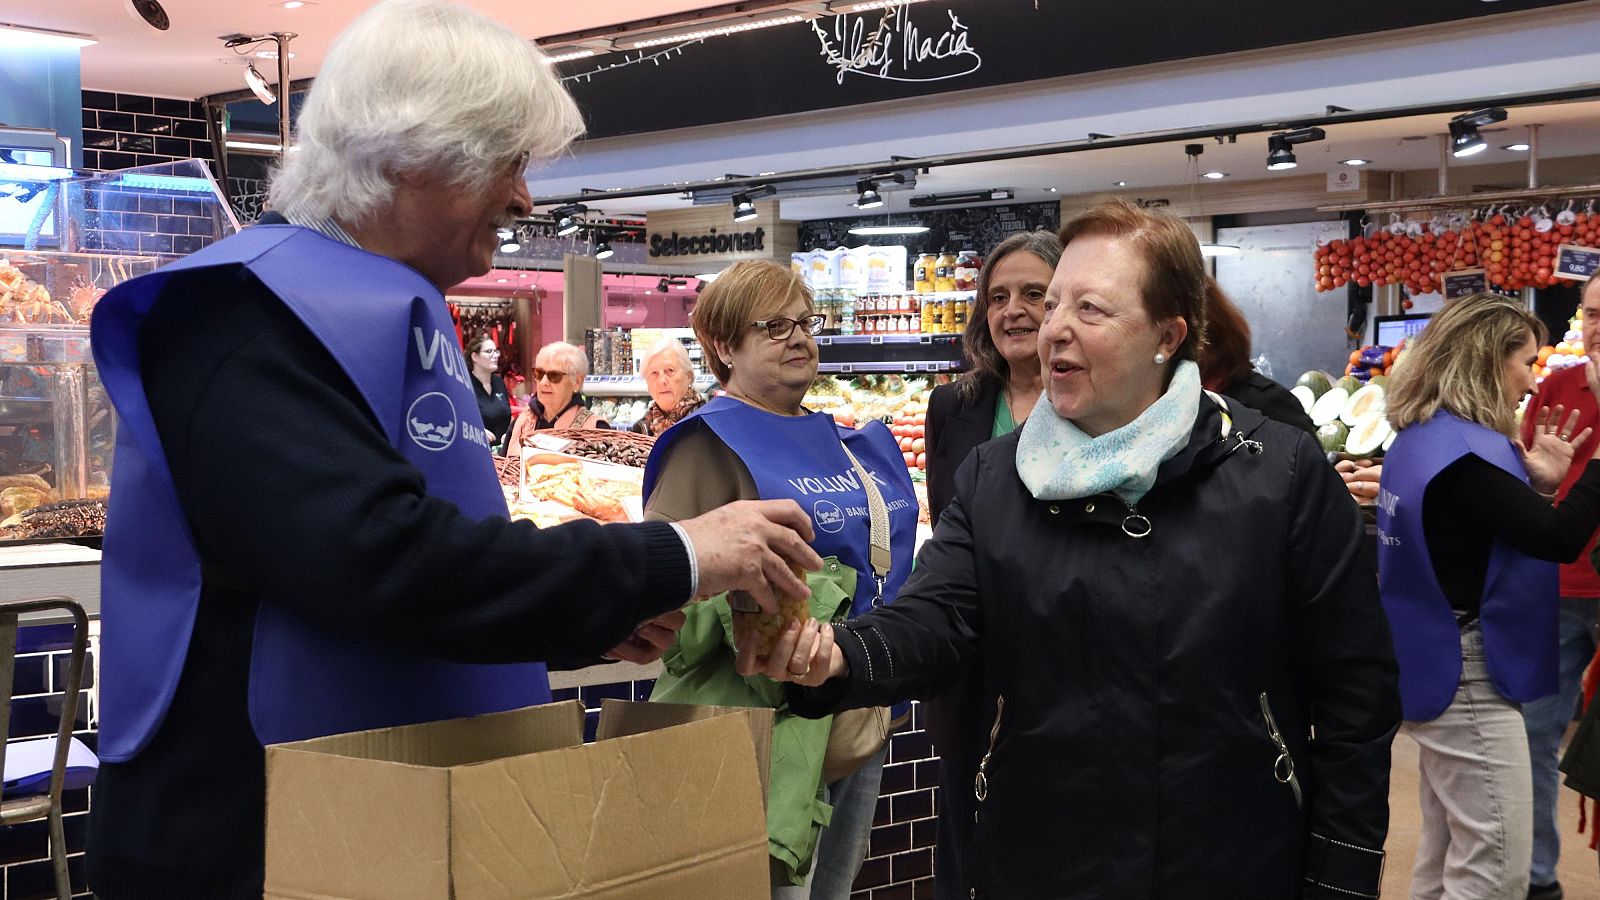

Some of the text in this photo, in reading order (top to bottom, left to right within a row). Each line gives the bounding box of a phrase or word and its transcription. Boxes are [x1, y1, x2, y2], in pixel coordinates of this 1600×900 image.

[896, 3, 974, 70] Macià
[649, 227, 765, 257] Seleccionat
[886, 498, 909, 513] MENTS
